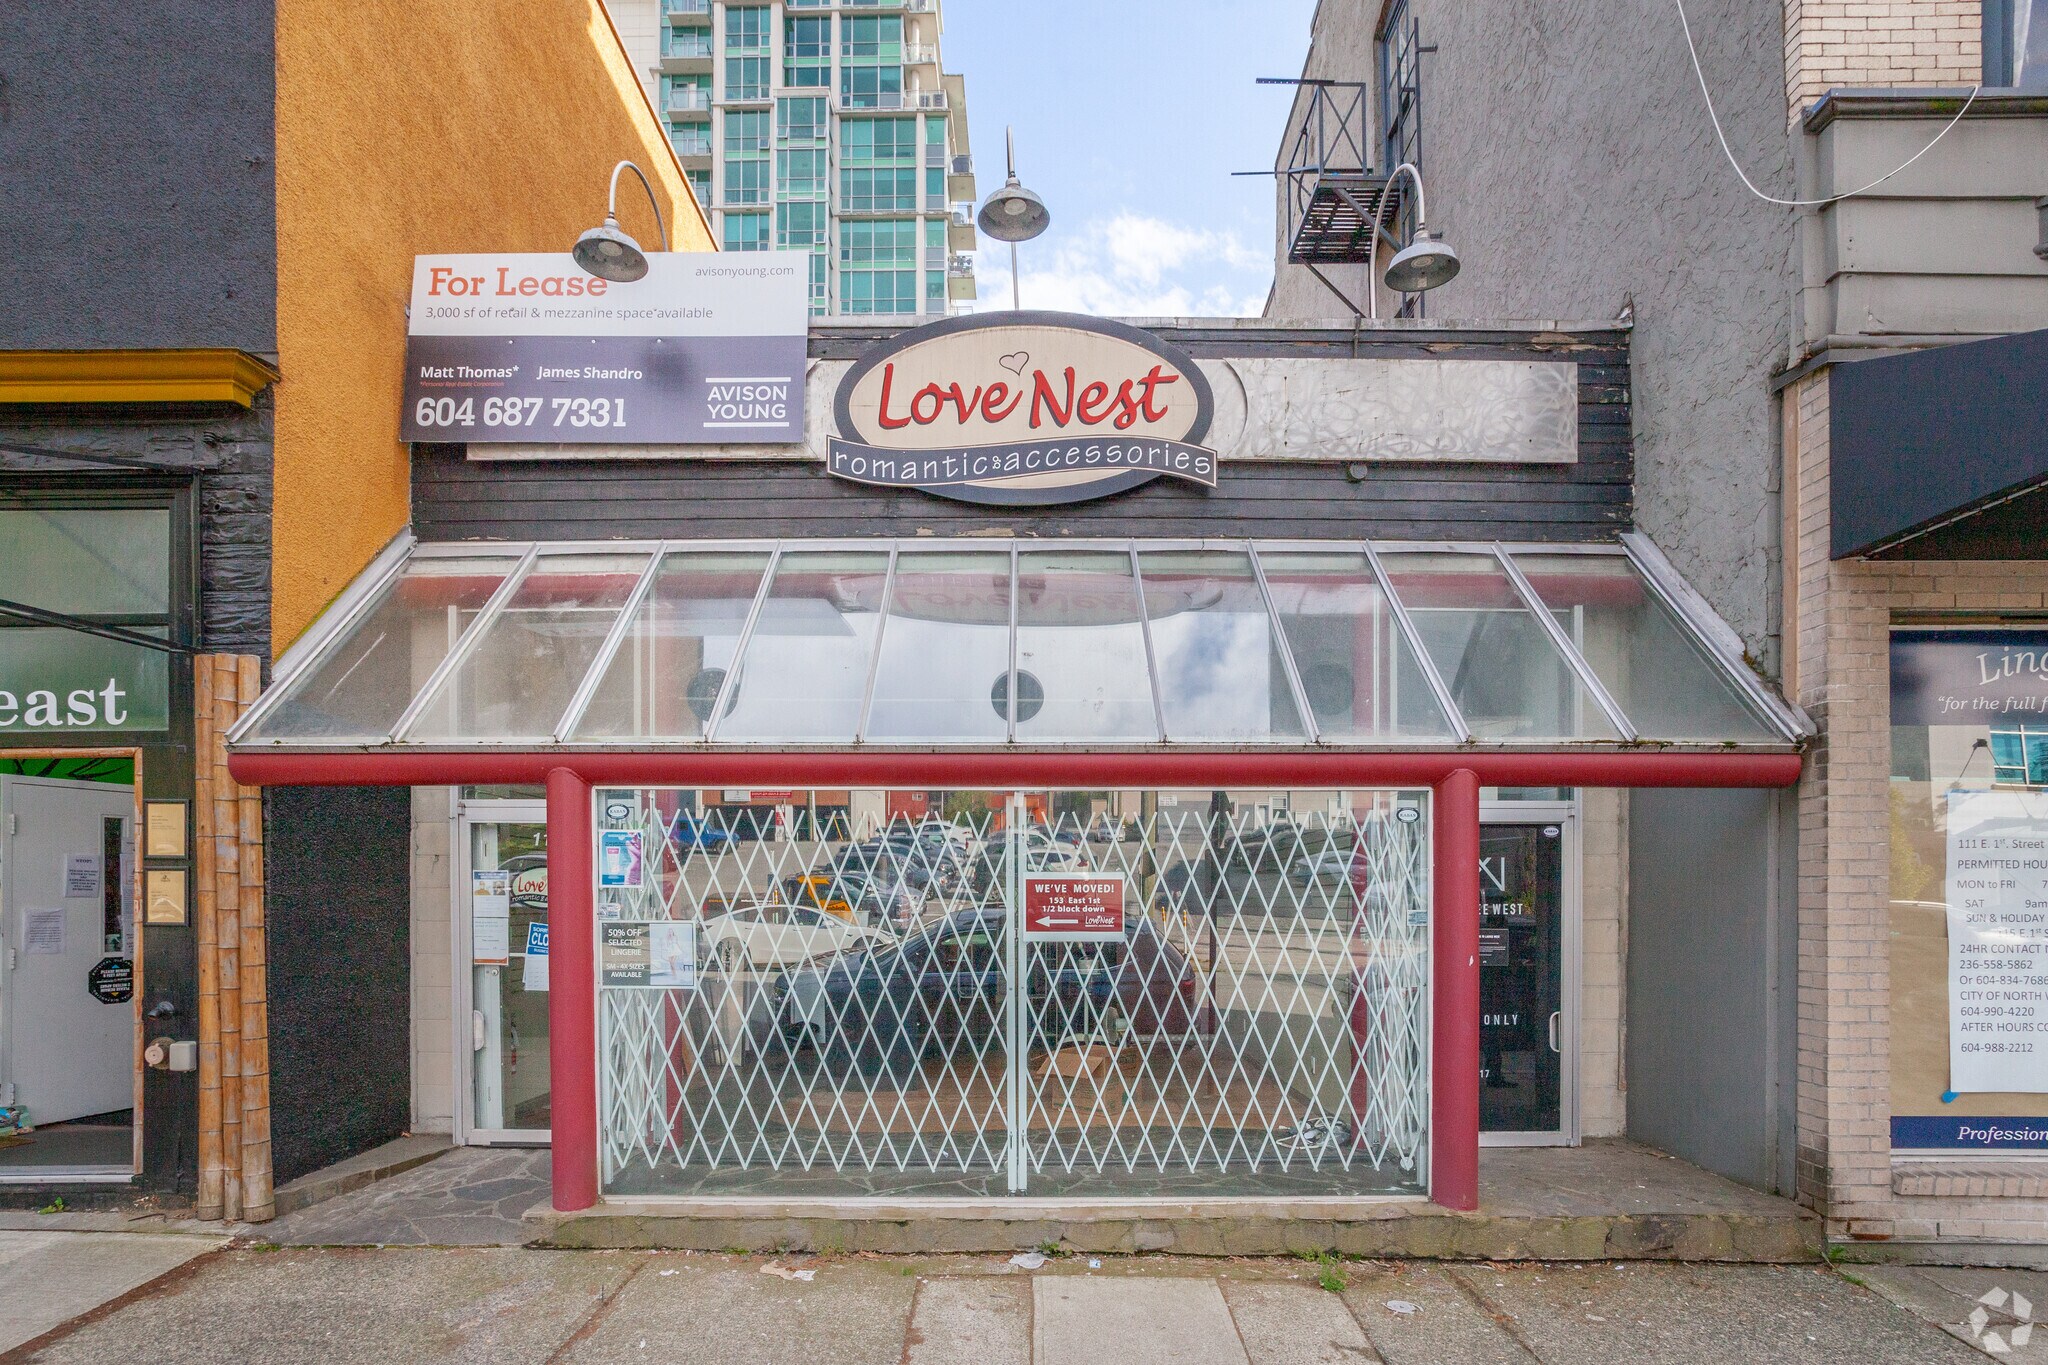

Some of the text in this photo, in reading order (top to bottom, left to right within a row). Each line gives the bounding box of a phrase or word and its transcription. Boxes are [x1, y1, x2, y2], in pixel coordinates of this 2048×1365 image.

[695, 265, 794, 280] avisonyoung.com
[428, 267, 608, 297] For Lease
[426, 306, 713, 322] 3,000 sf of retail & mezzanine space available
[420, 366, 455, 378] Matt
[536, 366, 580, 380] James
[583, 367, 643, 381] Shandro
[707, 385, 788, 402] AVISON
[878, 362, 1180, 431] Love Nest
[415, 397, 626, 428] 604 687 7331
[707, 403, 787, 420] YOUNG
[835, 448, 988, 481] romantic
[1003, 442, 1212, 476] accessories
[1972, 696, 2000, 710] the
[2002, 696, 2036, 714] full
[1958, 839, 1977, 849] 111
[1981, 839, 1990, 849] E.
[2012, 839, 2045, 849] Street
[1957, 859, 2048, 869] PERMITTED HOU
[517, 876, 547, 893] Love
[1073, 883, 1115, 893] MOVED!
[1957, 880, 1985, 889] MON
[1988, 879, 1998, 889] to
[2000, 880, 2016, 889] FRI
[1048, 896, 1101, 904] 153 East 1st
[1964, 899, 2048, 909] SAT 9am
[1042, 905, 1105, 913] 1/2 block down
[1492, 903, 1524, 915] WEST
[1966, 913, 2045, 923] SUN & HOLIDAY
[607, 928, 642, 937] 50% OFF
[610, 948, 642, 956] LINGERIE
[1960, 944, 1988, 954] 24HR
[1991, 944, 2042, 954] CONTACT
[1959, 959, 2033, 970] 236-558-5862
[1959, 975, 1973, 985] Or
[1960, 991, 1984, 1001] CITY
[1986, 991, 2000, 1001] OF
[2003, 991, 2042, 1001] NORTH
[1960, 1006, 2035, 1017] 604-990-4220
[1483, 1014, 1518, 1026] ONLY
[1961, 1022, 1994, 1032] AFTER
[1997, 1022, 2034, 1032] HOURS
[1961, 1043, 2034, 1053] 604-988-2212
